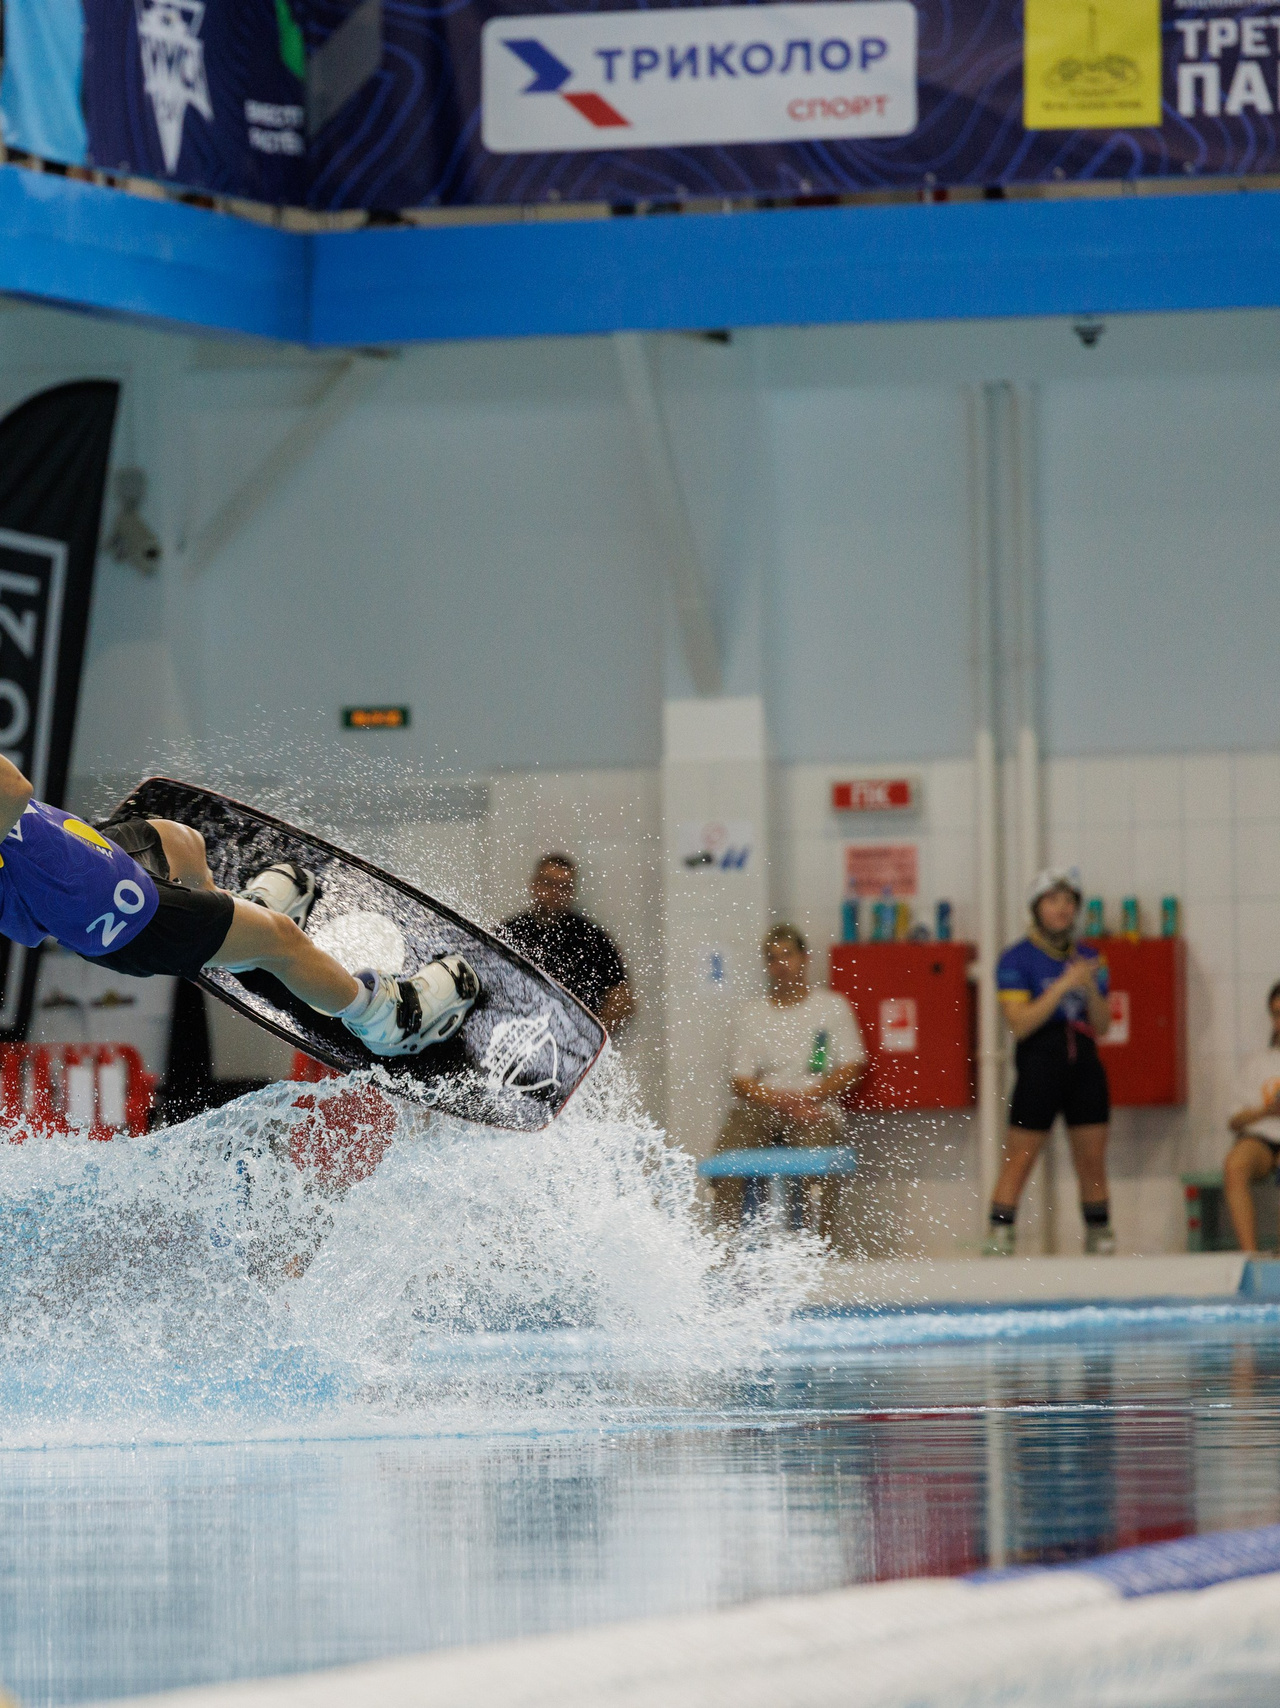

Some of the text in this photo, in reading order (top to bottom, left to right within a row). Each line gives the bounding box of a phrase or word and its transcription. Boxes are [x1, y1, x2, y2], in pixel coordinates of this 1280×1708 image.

[594, 36, 888, 82] ТРИКОЛОР
[786, 94, 888, 122] СПОРТ
[1177, 60, 1280, 118] ПА
[86, 879, 145, 948] 20
